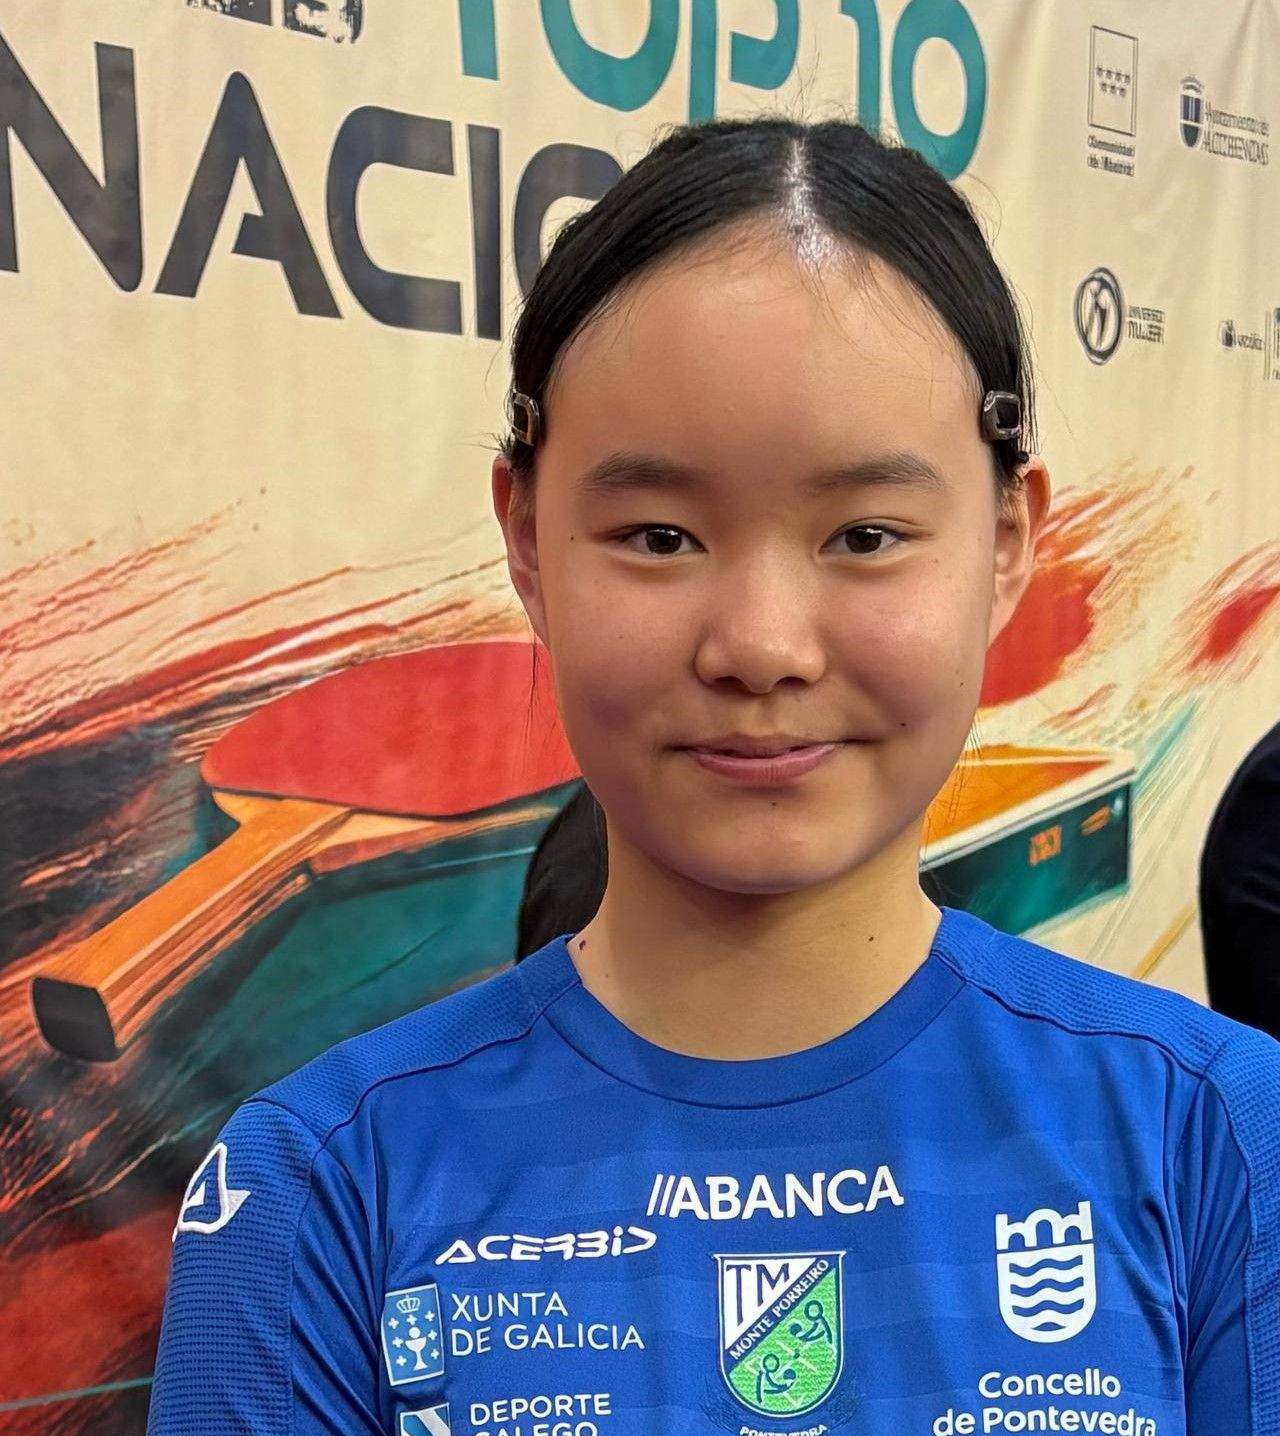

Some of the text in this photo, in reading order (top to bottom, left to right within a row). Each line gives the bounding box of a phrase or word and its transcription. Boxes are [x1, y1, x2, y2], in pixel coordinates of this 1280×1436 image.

[451, 1291, 568, 1323] XUNTA
[726, 1262, 790, 1327] TM
[729, 1259, 829, 1360] MONTE PORREIRO
[451, 1324, 646, 1357] DE GALICIA
[978, 1368, 1121, 1398] Concello
[470, 1393, 612, 1426] DEPORTE
